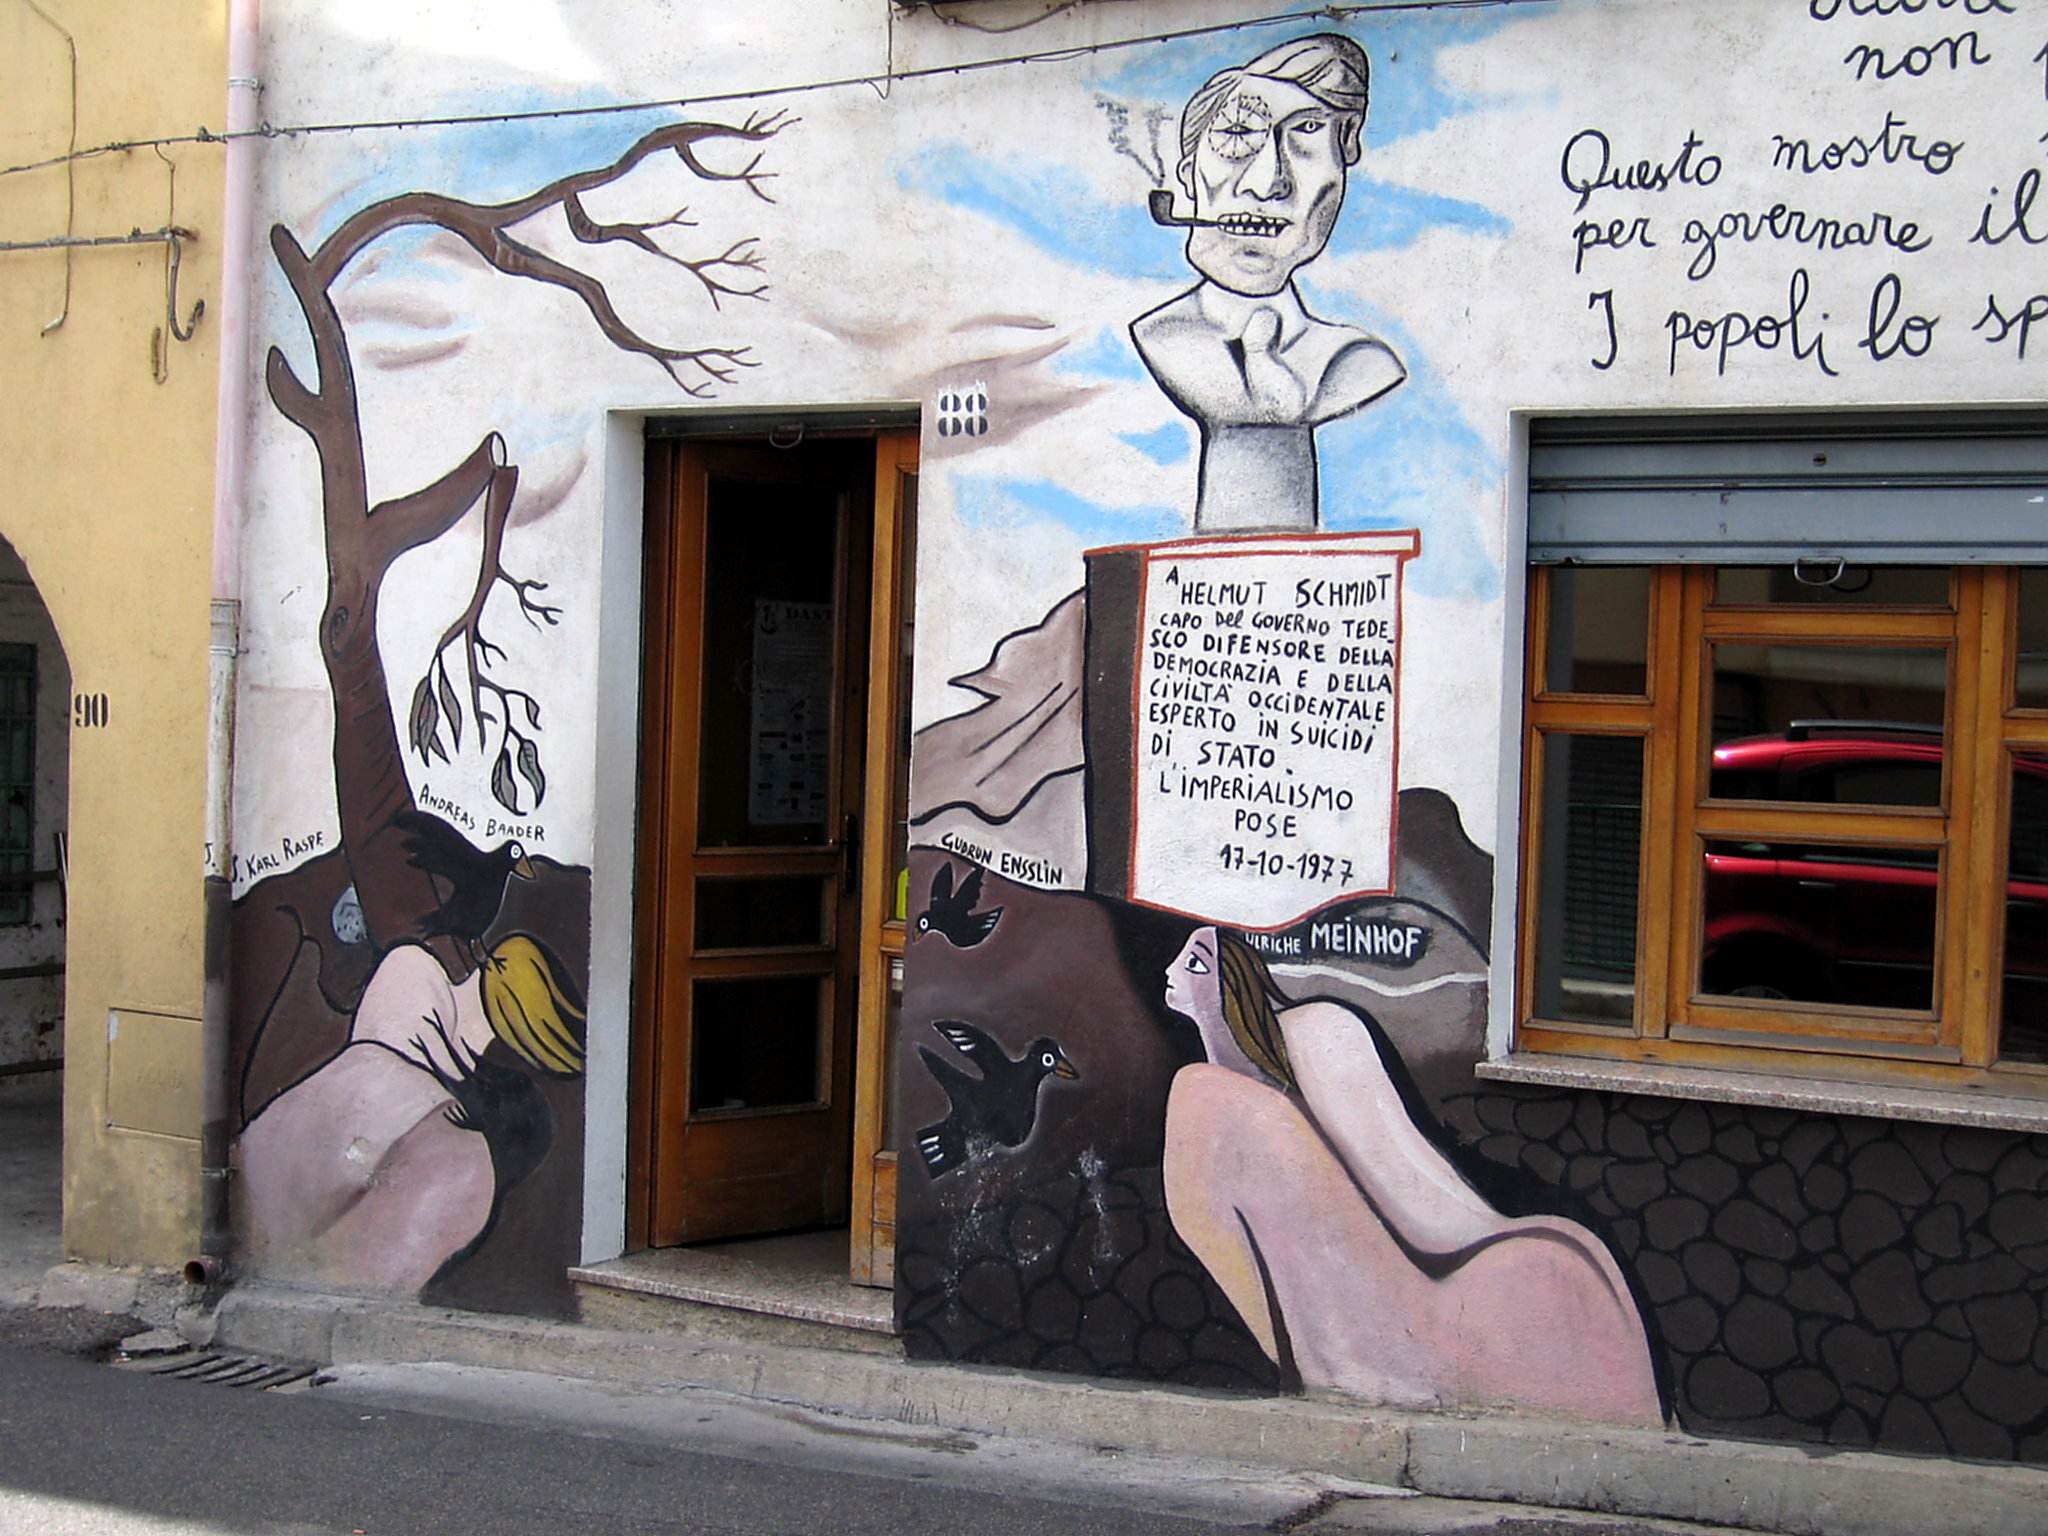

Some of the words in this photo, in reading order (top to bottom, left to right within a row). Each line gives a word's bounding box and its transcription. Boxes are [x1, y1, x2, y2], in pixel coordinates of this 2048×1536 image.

[1844, 31, 1992, 81] non
[1561, 129, 1722, 214] Questo
[1772, 111, 1966, 175] mostro
[1572, 217, 1656, 274] per
[1682, 203, 1933, 281] governare
[1968, 168, 2048, 245] il
[1665, 268, 1839, 377] popoli
[1858, 273, 1941, 361] lo
[938, 393, 988, 437] 88
[1166, 566, 1179, 585] A
[1181, 581, 1267, 606] HELMUT
[1295, 574, 1392, 608] SCHMIDT
[1160, 612, 1201, 630] CAPO
[1252, 611, 1330, 637] GOVERNO
[1149, 629, 1187, 648] SCO
[1203, 634, 1326, 663] DIFENSORE
[1339, 646, 1394, 668] DELLA
[1153, 652, 1281, 686] DEMOCRAZIA
[1297, 669, 1308, 688] E
[1327, 674, 1392, 694] DELLA
[75, 693, 108, 728] 90
[1248, 691, 1386, 722] OCCIDENTALE
[1149, 703, 1236, 732] ESPERTO
[1258, 714, 1278, 740] IN
[1290, 720, 1377, 754] SUICIDI
[1151, 730, 1172, 757] DI
[419, 783, 475, 830] ANDREAS
[485, 819, 545, 842] BAADER
[1235, 809, 1297, 838] POSE
[246, 854, 280, 879] KARL
[941, 833, 992, 865] GUDRUN
[1001, 853, 1062, 884] ENSSLIN
[1220, 844, 1354, 886] 17-10-1977
[1311, 916, 1421, 958] MEINHOF
